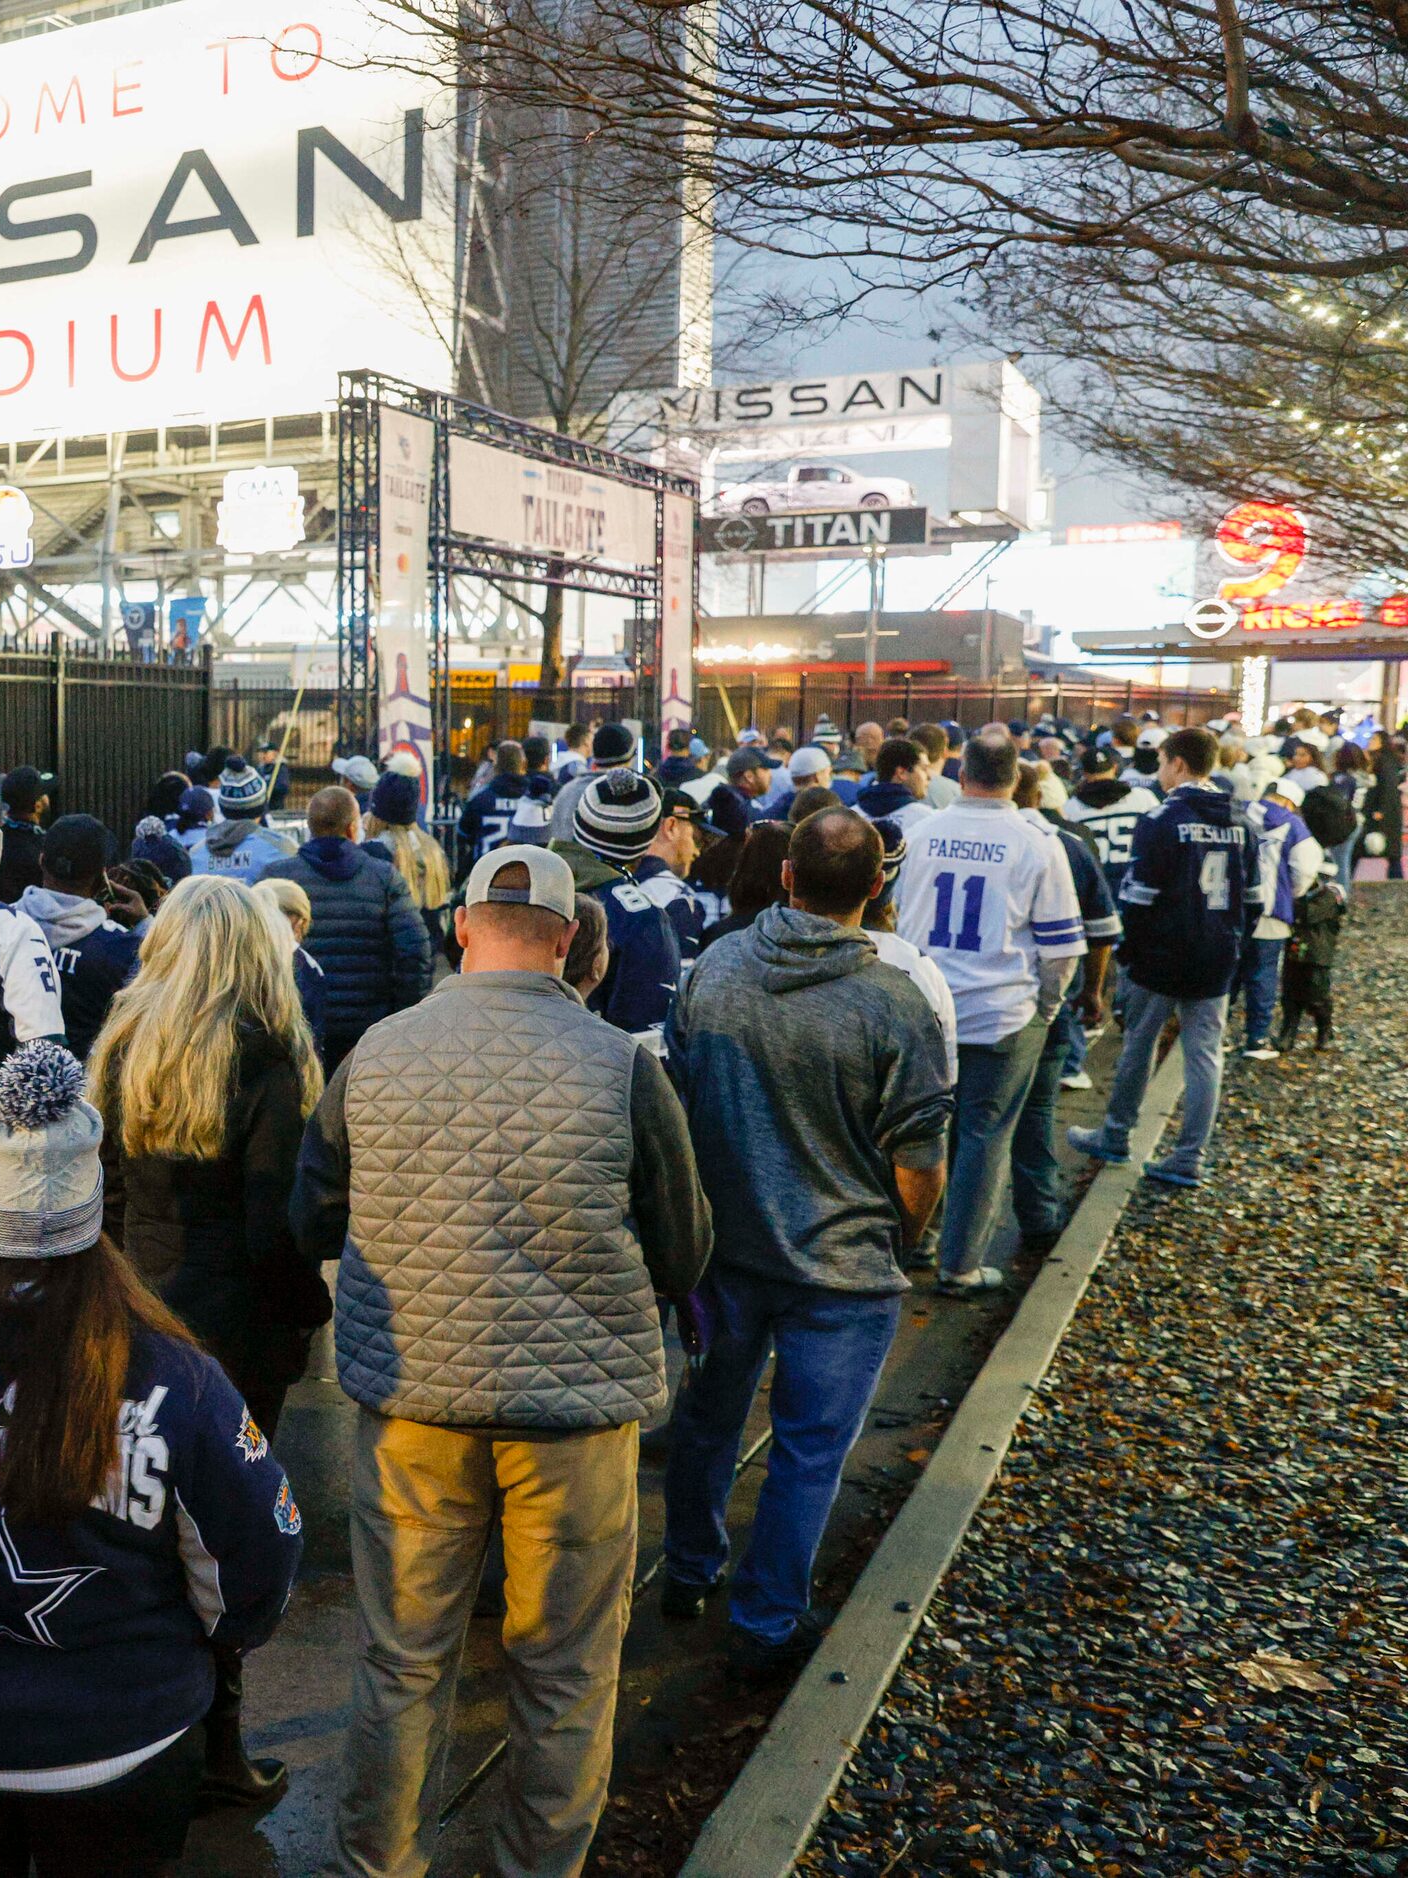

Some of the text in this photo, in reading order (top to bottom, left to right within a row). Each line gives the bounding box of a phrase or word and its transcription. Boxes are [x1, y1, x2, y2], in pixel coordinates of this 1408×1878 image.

[205, 22, 323, 95] TO
[658, 373, 942, 422] NISSAN
[521, 493, 605, 554] TAILGATE
[766, 511, 891, 548] TITAN
[927, 838, 1007, 863] PARSONS
[1198, 850, 1231, 911] 4
[927, 871, 986, 952] 11
